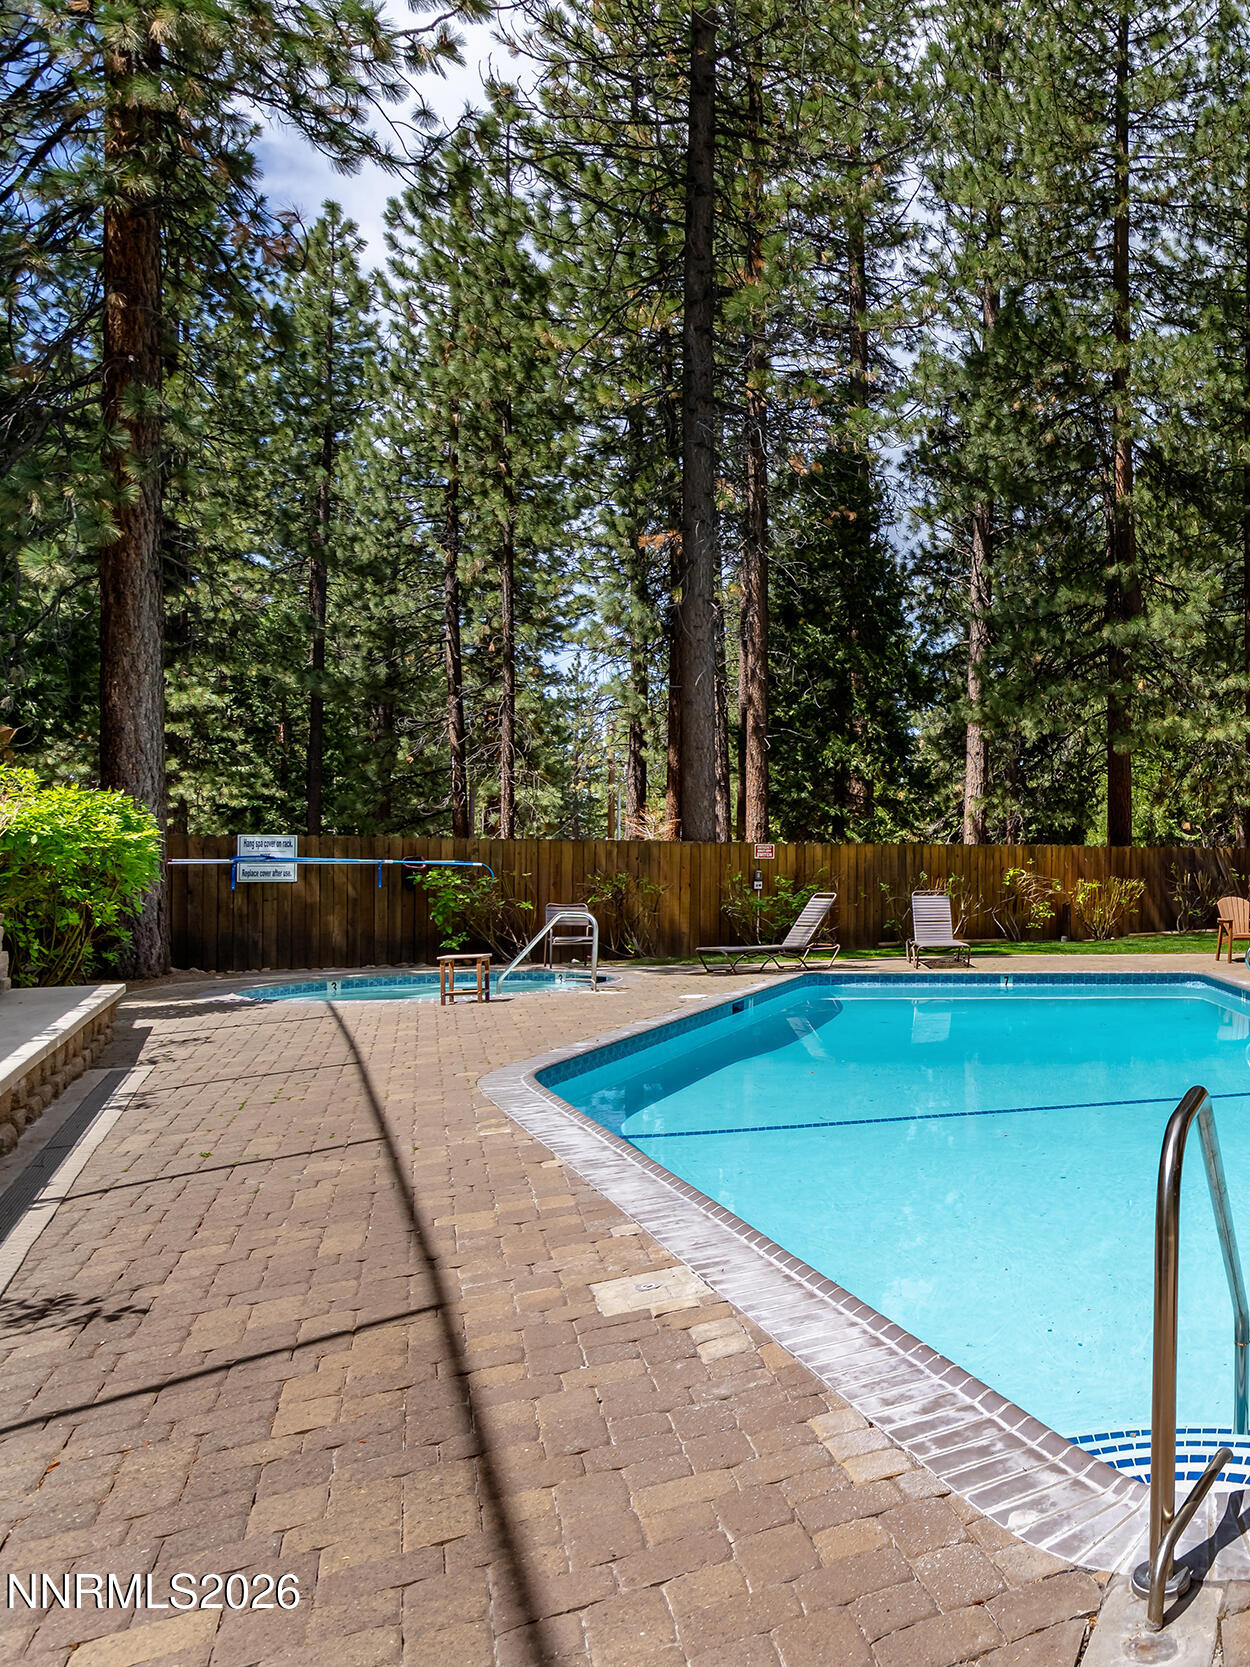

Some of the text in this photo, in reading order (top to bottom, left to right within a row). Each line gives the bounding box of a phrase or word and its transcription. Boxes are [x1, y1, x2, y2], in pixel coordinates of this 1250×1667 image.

[243, 839, 254, 850] Hang
[256, 840, 264, 850] spa
[242, 868, 259, 878] Replace
[272, 868, 282, 877] after
[1004, 976, 1008, 986] 7
[331, 982, 337, 991] 3
